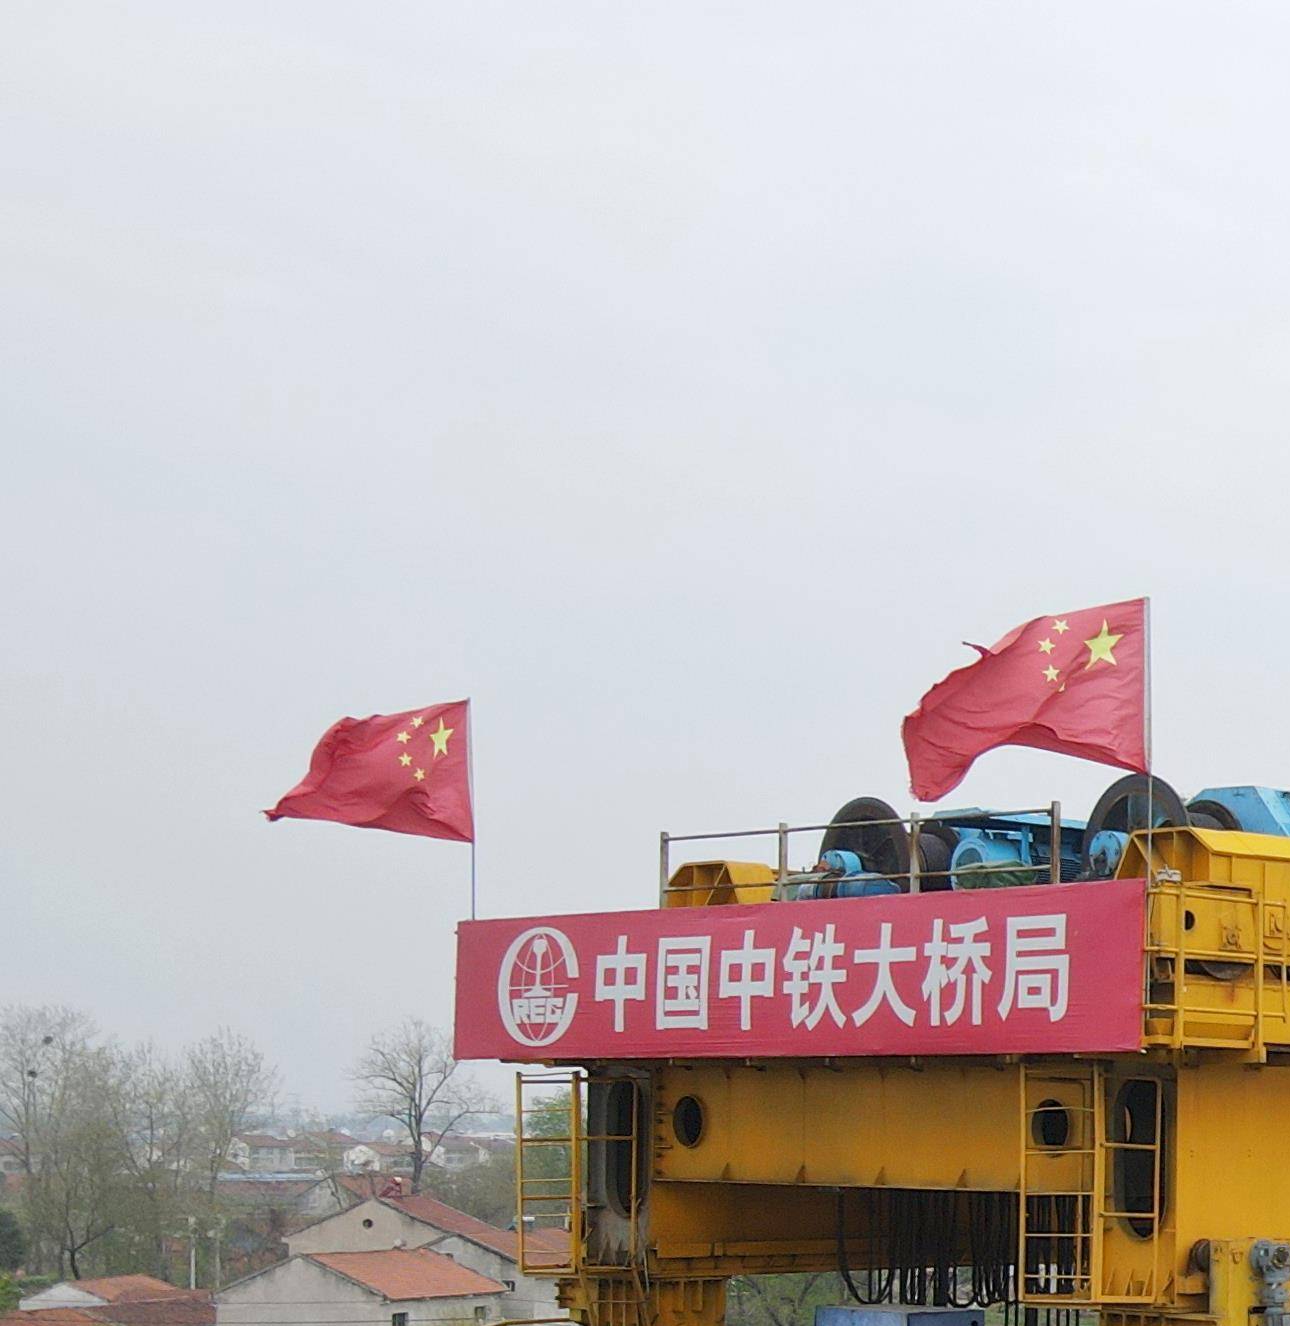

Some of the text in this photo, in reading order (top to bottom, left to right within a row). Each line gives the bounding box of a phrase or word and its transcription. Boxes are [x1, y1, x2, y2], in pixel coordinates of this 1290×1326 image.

[595, 914, 1069, 1032] 中国中铁大桥局
